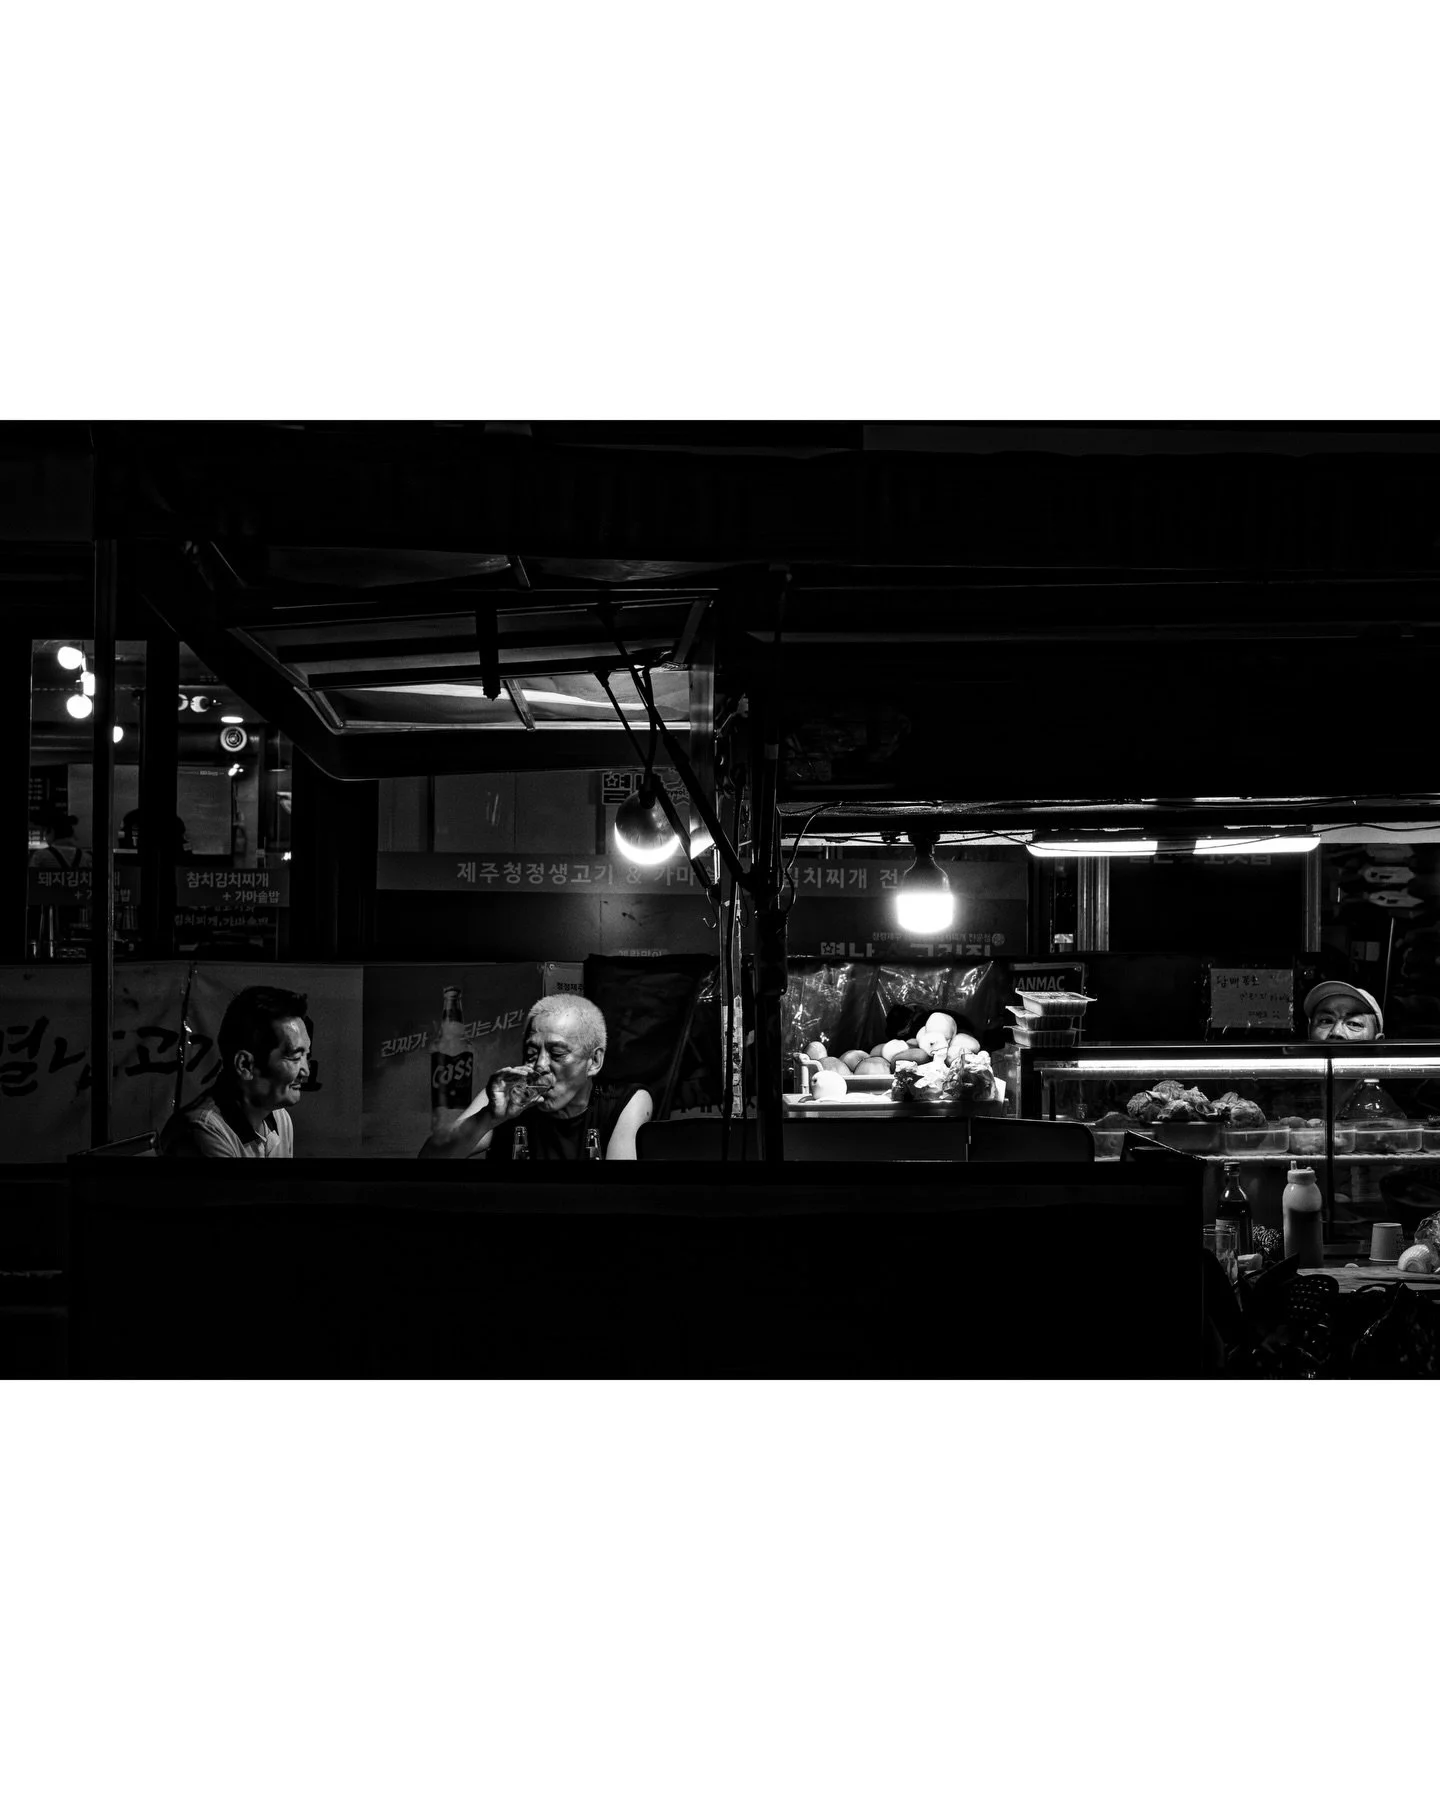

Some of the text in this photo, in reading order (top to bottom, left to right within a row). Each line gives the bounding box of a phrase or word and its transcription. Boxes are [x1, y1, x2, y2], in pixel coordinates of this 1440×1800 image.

[186, 871, 269, 889] 참치김치찌개
[456, 861, 613, 885] 제주청정생고기
[625, 863, 642, 885] &
[234, 890, 280, 904] 가마솥밥
[381, 1031, 429, 1058] 진짜가
